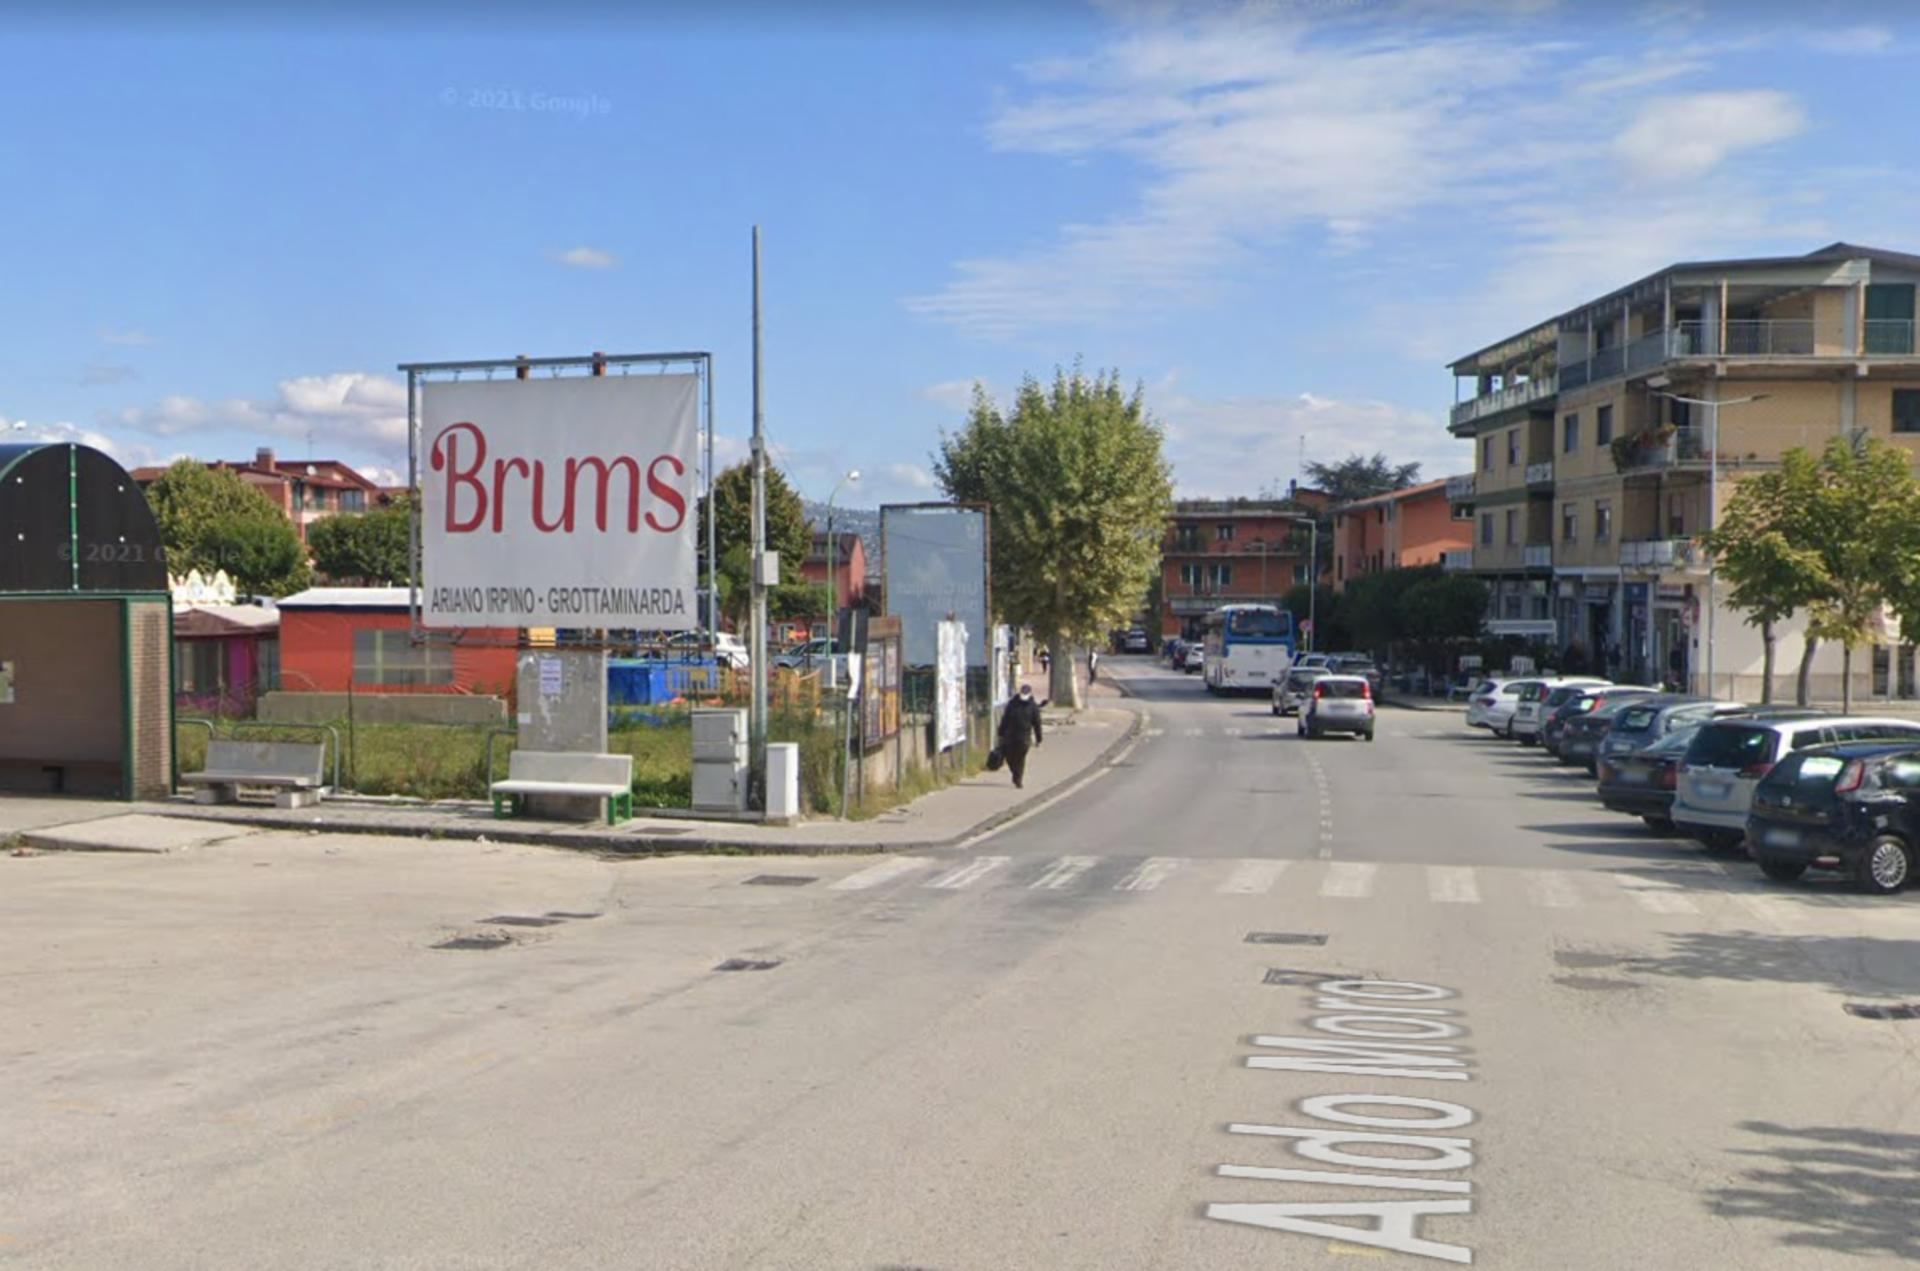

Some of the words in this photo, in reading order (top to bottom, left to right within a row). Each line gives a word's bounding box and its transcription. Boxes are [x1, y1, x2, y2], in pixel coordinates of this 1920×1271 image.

[431, 422, 686, 534] Brums
[431, 587, 483, 613] ARIANO
[485, 587, 534, 613] IRPINO
[548, 588, 685, 615] GROTTAMINARDA
